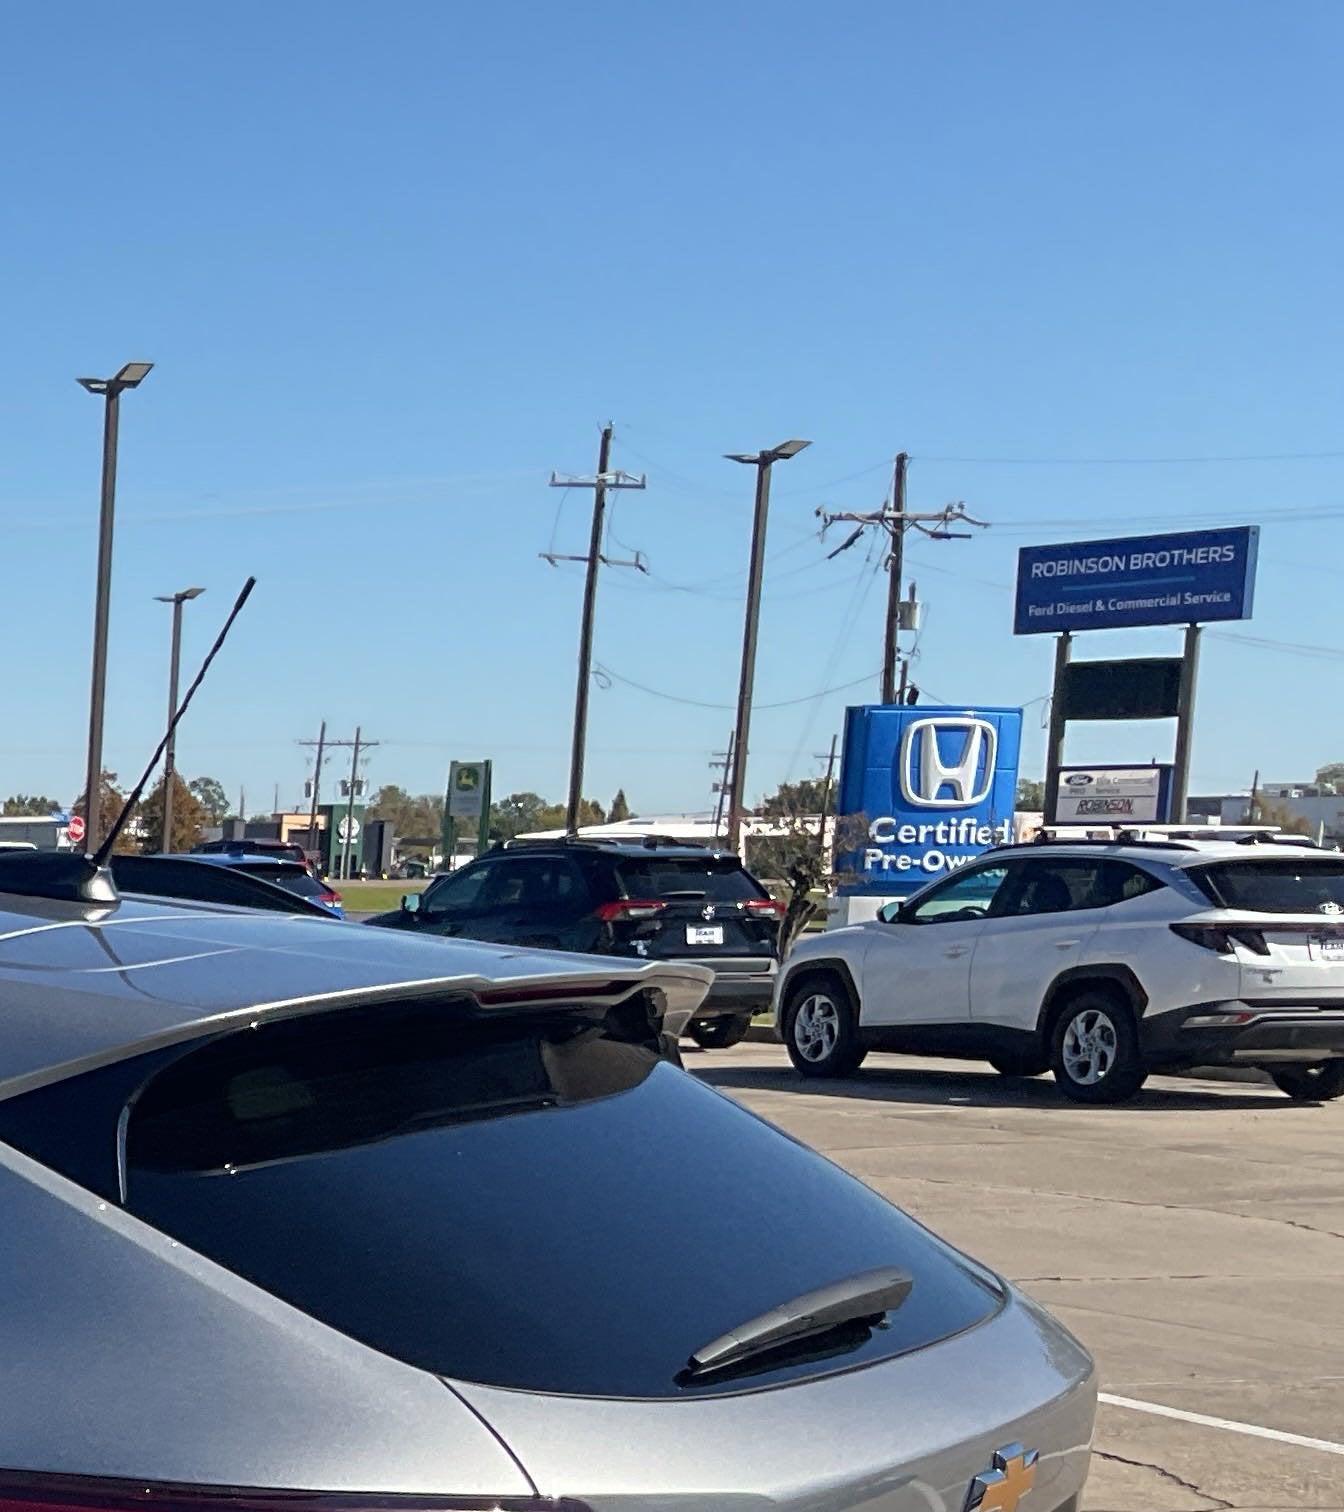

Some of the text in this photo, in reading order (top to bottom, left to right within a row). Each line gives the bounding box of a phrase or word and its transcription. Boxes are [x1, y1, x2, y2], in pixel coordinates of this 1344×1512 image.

[1031, 545, 1235, 578] ROBINSON BROTHERS
[1028, 591, 1231, 617] Ford Diesel & Commercial Service
[868, 816, 1011, 844] Certified
[864, 848, 977, 872] Pre-Ow
